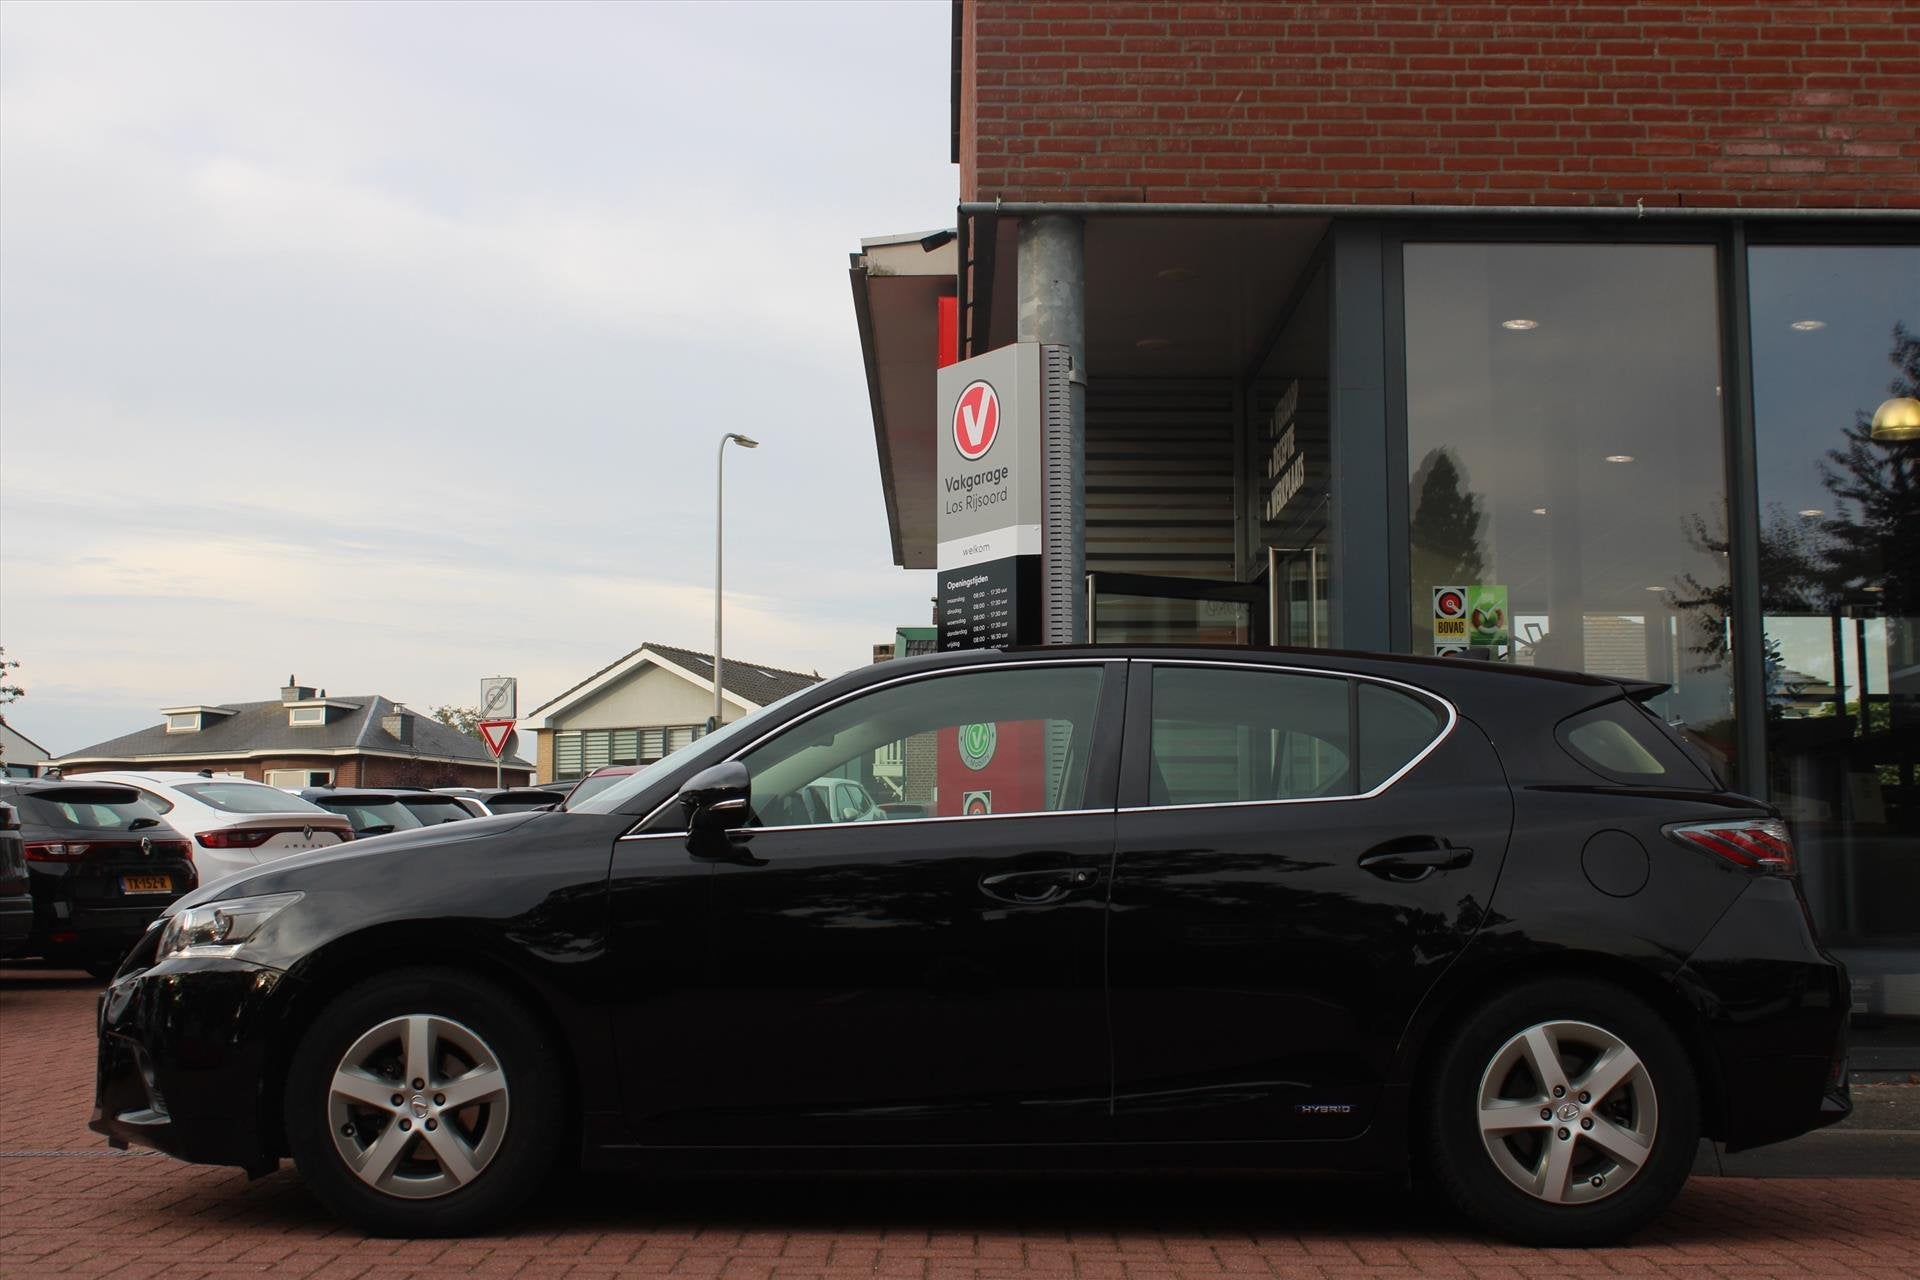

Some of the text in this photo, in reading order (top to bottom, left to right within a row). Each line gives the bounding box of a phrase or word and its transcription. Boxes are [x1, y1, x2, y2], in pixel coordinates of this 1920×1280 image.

[945, 466, 1009, 493] Vakgarage
[945, 486, 1007, 515] Los Rijsoord
[962, 543, 990, 556] welkom
[946, 575, 989, 591] Openingstijden
[1438, 621, 1464, 634] BOVAG
[1302, 1105, 1351, 1113] HYBRID
